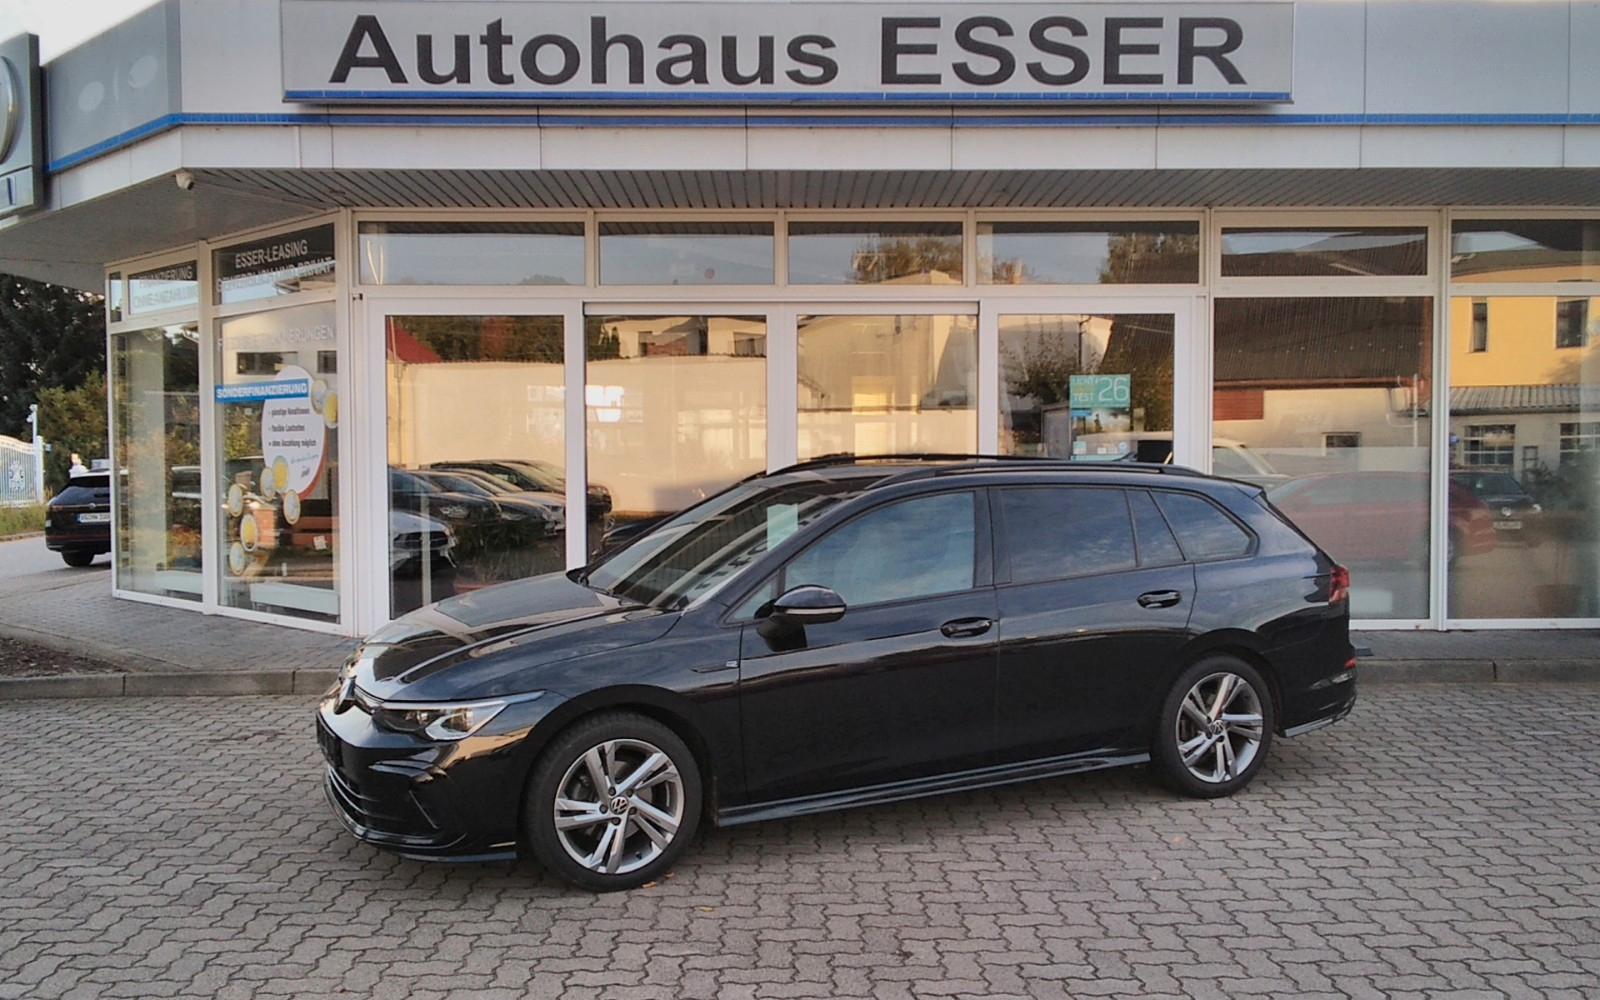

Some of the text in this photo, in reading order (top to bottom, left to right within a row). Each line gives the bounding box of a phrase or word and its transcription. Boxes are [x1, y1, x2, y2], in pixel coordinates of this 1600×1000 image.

[329, 17, 1245, 85] Autohaus ESSER
[235, 239, 308, 269] ESSER-LEASING
[1098, 377, 1129, 401] 26
